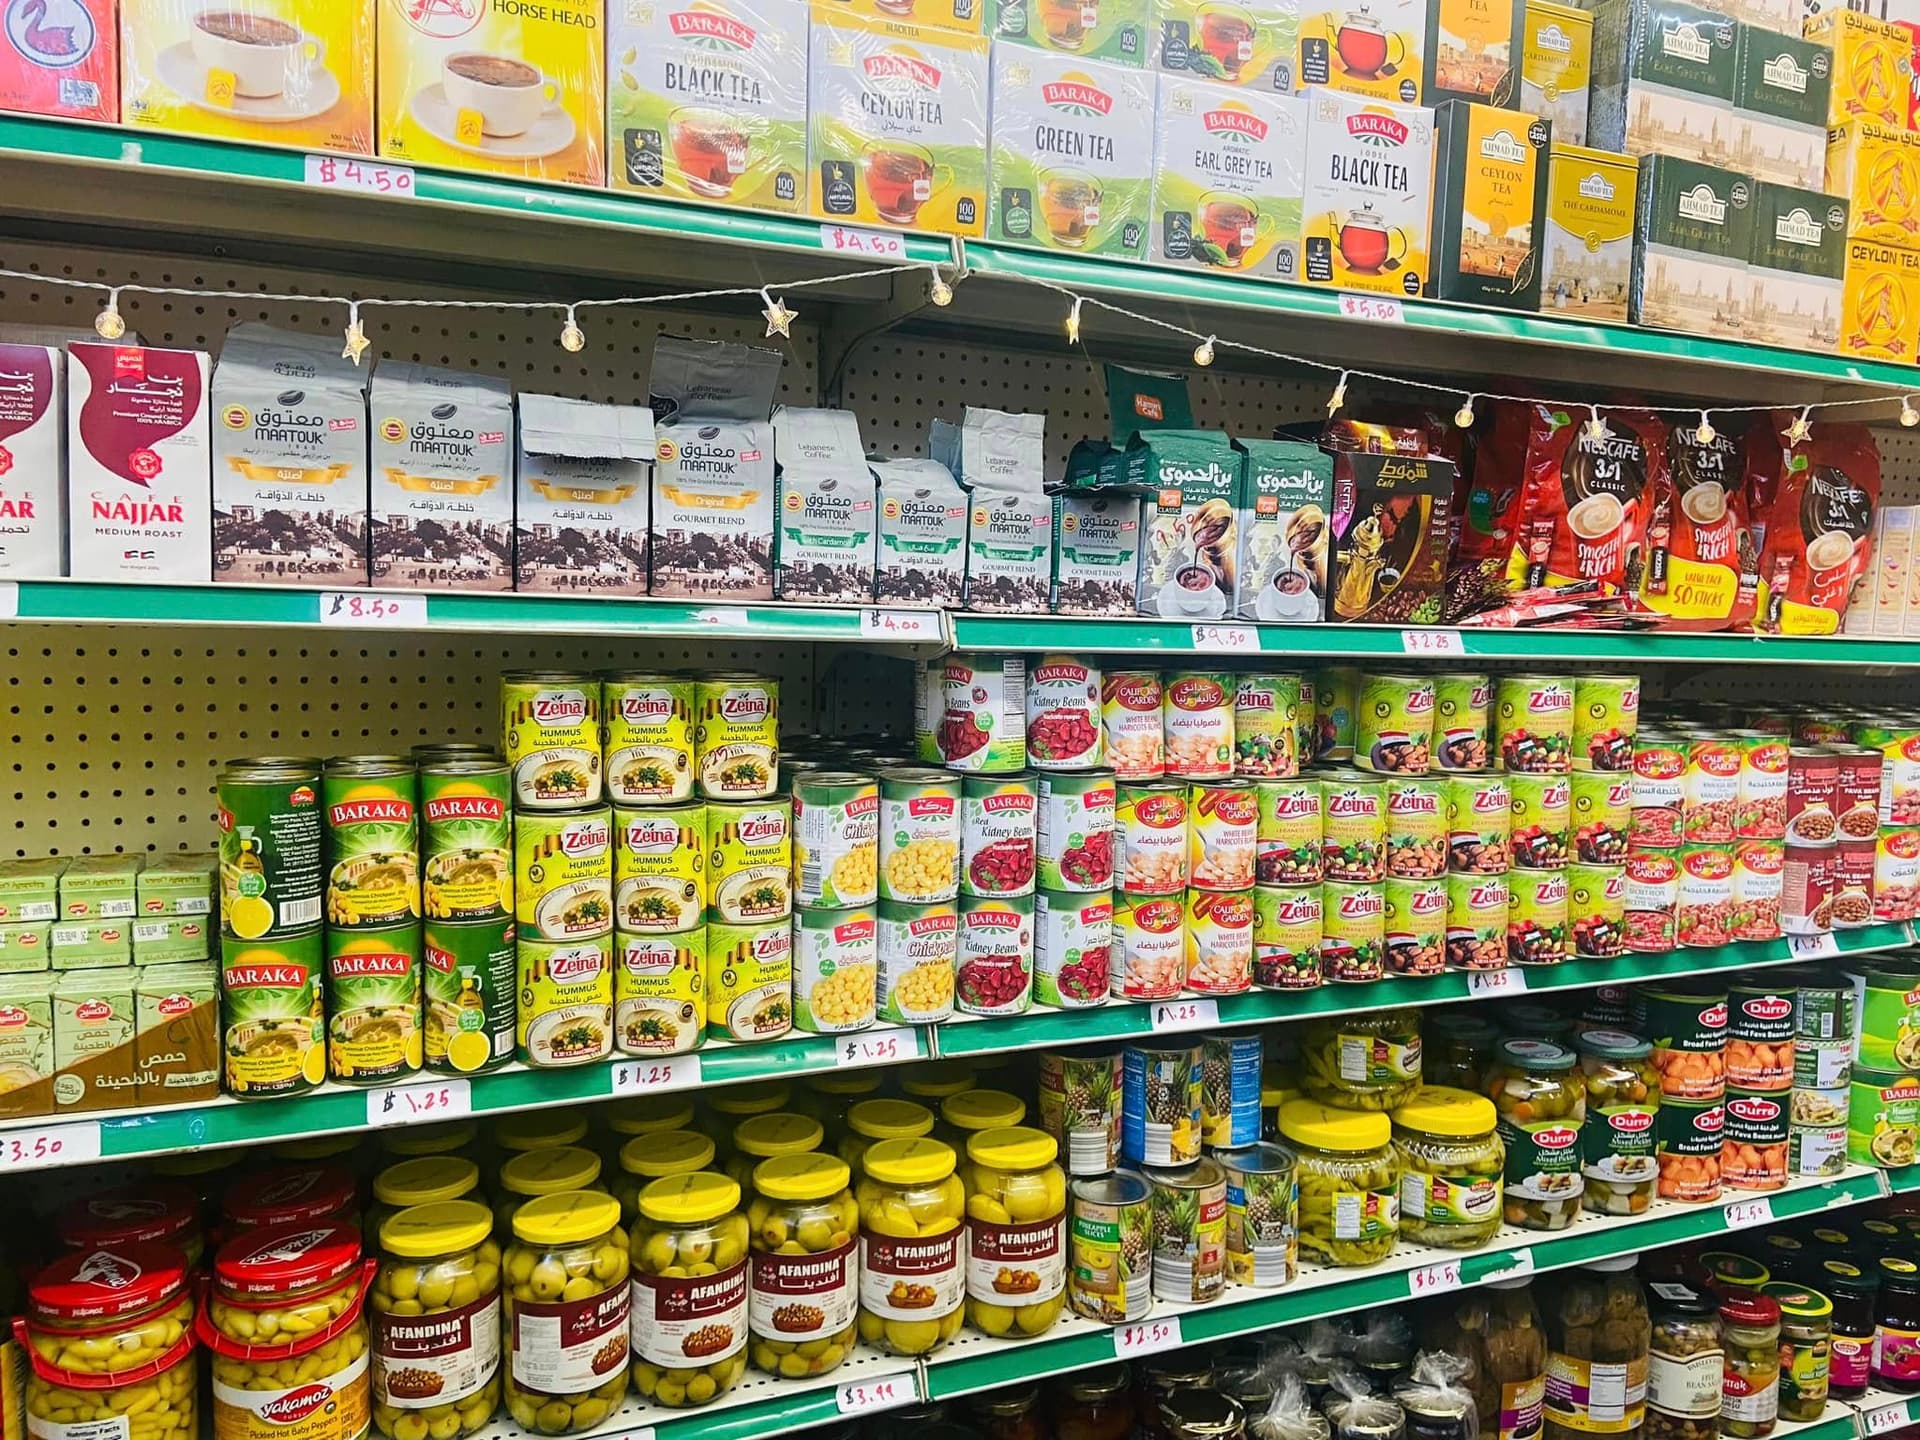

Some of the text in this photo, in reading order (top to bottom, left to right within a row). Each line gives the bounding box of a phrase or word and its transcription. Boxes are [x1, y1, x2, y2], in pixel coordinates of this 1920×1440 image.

[492, 1, 597, 30] HORSE HEAD
[1469, 2, 1489, 13] TEA
[665, 62, 761, 104] BLACK TEA
[1766, 68, 1805, 86] AHMAD TEA
[1048, 82, 1107, 115] BARAKA
[861, 94, 943, 125] CEYLON TEA
[1209, 113, 1263, 137] BARAKA
[1352, 116, 1403, 142] BARAKA
[1036, 125, 1114, 162] GREEN TEA
[1482, 140, 1526, 159] AHMAD TEA
[1195, 151, 1273, 179] EARL GREY TEA
[321, 159, 411, 191] $4.50
[1331, 155, 1408, 192] BLACK TEA
[1481, 167, 1522, 183] CEYLON
[776, 175, 793, 191] 100
[1492, 182, 1512, 196] TEA
[958, 201, 974, 215] 100
[1681, 200, 1725, 216] AHMAD TEA
[1778, 225, 1820, 239] AHMAD TEA
[834, 229, 898, 253] $4.50
[1852, 246, 1920, 268] CEYLON TEA
[1345, 298, 1395, 319] $5.50
[686, 384, 732, 394] Lebanese
[689, 391, 723, 400] Coffee
[256, 410, 323, 428] معتوق
[255, 428, 323, 444] MAATOUK
[410, 425, 474, 441] معتوق
[410, 441, 473, 457] MAATOUK
[680, 446, 735, 460] معتوق
[797, 443, 836, 452] Lebanese
[803, 450, 832, 459] Coffee
[680, 460, 735, 474] MAATOUK
[985, 456, 1018, 466] Lebanese
[989, 465, 1014, 475] Coffee
[1590, 480, 1625, 493] CLASSIC
[295, 493, 325, 503] خلطة
[805, 495, 851, 508] معتوق
[93, 502, 184, 526] NAJJAR
[447, 503, 474, 512] خلطة
[805, 507, 851, 520] MAATOUK
[900, 501, 944, 515] معتوق
[1157, 506, 1182, 514] CLASSIC
[587, 511, 613, 521] خلطة
[673, 514, 745, 525] GOURMET BLEND
[900, 513, 944, 526] MAATOUK
[990, 510, 1032, 524] معتوق
[1080, 515, 1119, 529] معتوق
[1256, 512, 1278, 521] CLASSIC
[95, 528, 182, 538] MEDIUM ROAST
[989, 522, 1031, 534] MAATOUK
[1079, 527, 1119, 540] MAATOUK
[1156, 513, 1197, 548] 9.50
[1694, 528, 1731, 548] SMOOTH
[797, 551, 857, 560] GOURMET BLEND
[1578, 541, 1621, 560] SMOOTH
[982, 564, 1036, 573] GOURMET BLEND
[1071, 568, 1122, 577] GOURMET BLEND
[1673, 585, 1726, 608] 50 STICKS
[329, 595, 400, 618] $8.50
[871, 613, 920, 631] $4.00
[1195, 628, 1245, 645] $9.50
[1408, 633, 1449, 649] $2.25
[1037, 667, 1086, 681] BARAKA
[625, 698, 669, 714] Zeina
[725, 698, 765, 713] Zeina
[1033, 695, 1086, 710] Kidney Beans
[1127, 696, 1158, 706] GARDEN
[1530, 691, 1571, 708] Zeina
[537, 700, 583, 716] Zeina
[540, 728, 581, 737] HUMMUS
[628, 727, 668, 735] HUMMUS
[727, 725, 763, 733] HUMMUS
[1709, 763, 1738, 771] GARDEN
[428, 797, 500, 819] BARAKA
[914, 800, 950, 814] بركة
[987, 797, 1032, 810] BARAKA
[1278, 796, 1318, 813] Zeina
[1328, 796, 1376, 813] Zeina
[1390, 793, 1435, 810] Zeina
[333, 800, 408, 822] BARAKA
[743, 821, 782, 836] Zeina
[976, 816, 989, 826] Red
[566, 830, 606, 850] Zeina
[631, 828, 675, 844] Zeina
[982, 825, 1032, 839] Kidney Beans
[745, 848, 781, 856] HUMMUS
[569, 857, 606, 869] HUMMUS
[633, 857, 673, 865] HUMMUS
[1633, 868, 1667, 878] GARDEN
[1280, 902, 1319, 918] Zeina
[1342, 896, 1381, 913] Zeina
[970, 914, 1018, 928] BARAKA
[1221, 912, 1250, 922] GARDEN
[840, 924, 873, 939] بركة
[965, 939, 1018, 955] Kidney Beans
[332, 955, 405, 974] BARAKA
[554, 957, 598, 975] Zeina
[628, 950, 672, 966] Zeina
[225, 969, 302, 987] BARAKA
[630, 978, 670, 986] HUMMUS
[556, 983, 597, 995] HUMMUS
[846, 1038, 896, 1059] $1.25
[140, 1051, 186, 1069] حمص
[95, 1071, 160, 1089] بالطحينة
[618, 1065, 672, 1085] $1.25
[382, 1088, 449, 1113] $1.25
[1727, 1206, 1763, 1221] $2.50
[1078, 1221, 1111, 1234] PINEAPPLE
[1084, 1229, 1105, 1239] SLICES
[999, 1228, 1055, 1245] AFANDINA
[895, 1241, 952, 1258] AFANDINA
[778, 1259, 840, 1277] AFANDINA
[690, 1270, 745, 1300] AFANDINA
[1415, 1267, 1459, 1288] $6.5
[390, 1321, 462, 1339] AFANDINA
[1124, 1326, 1169, 1345] $2.50
[262, 1387, 331, 1418] yakamoz
